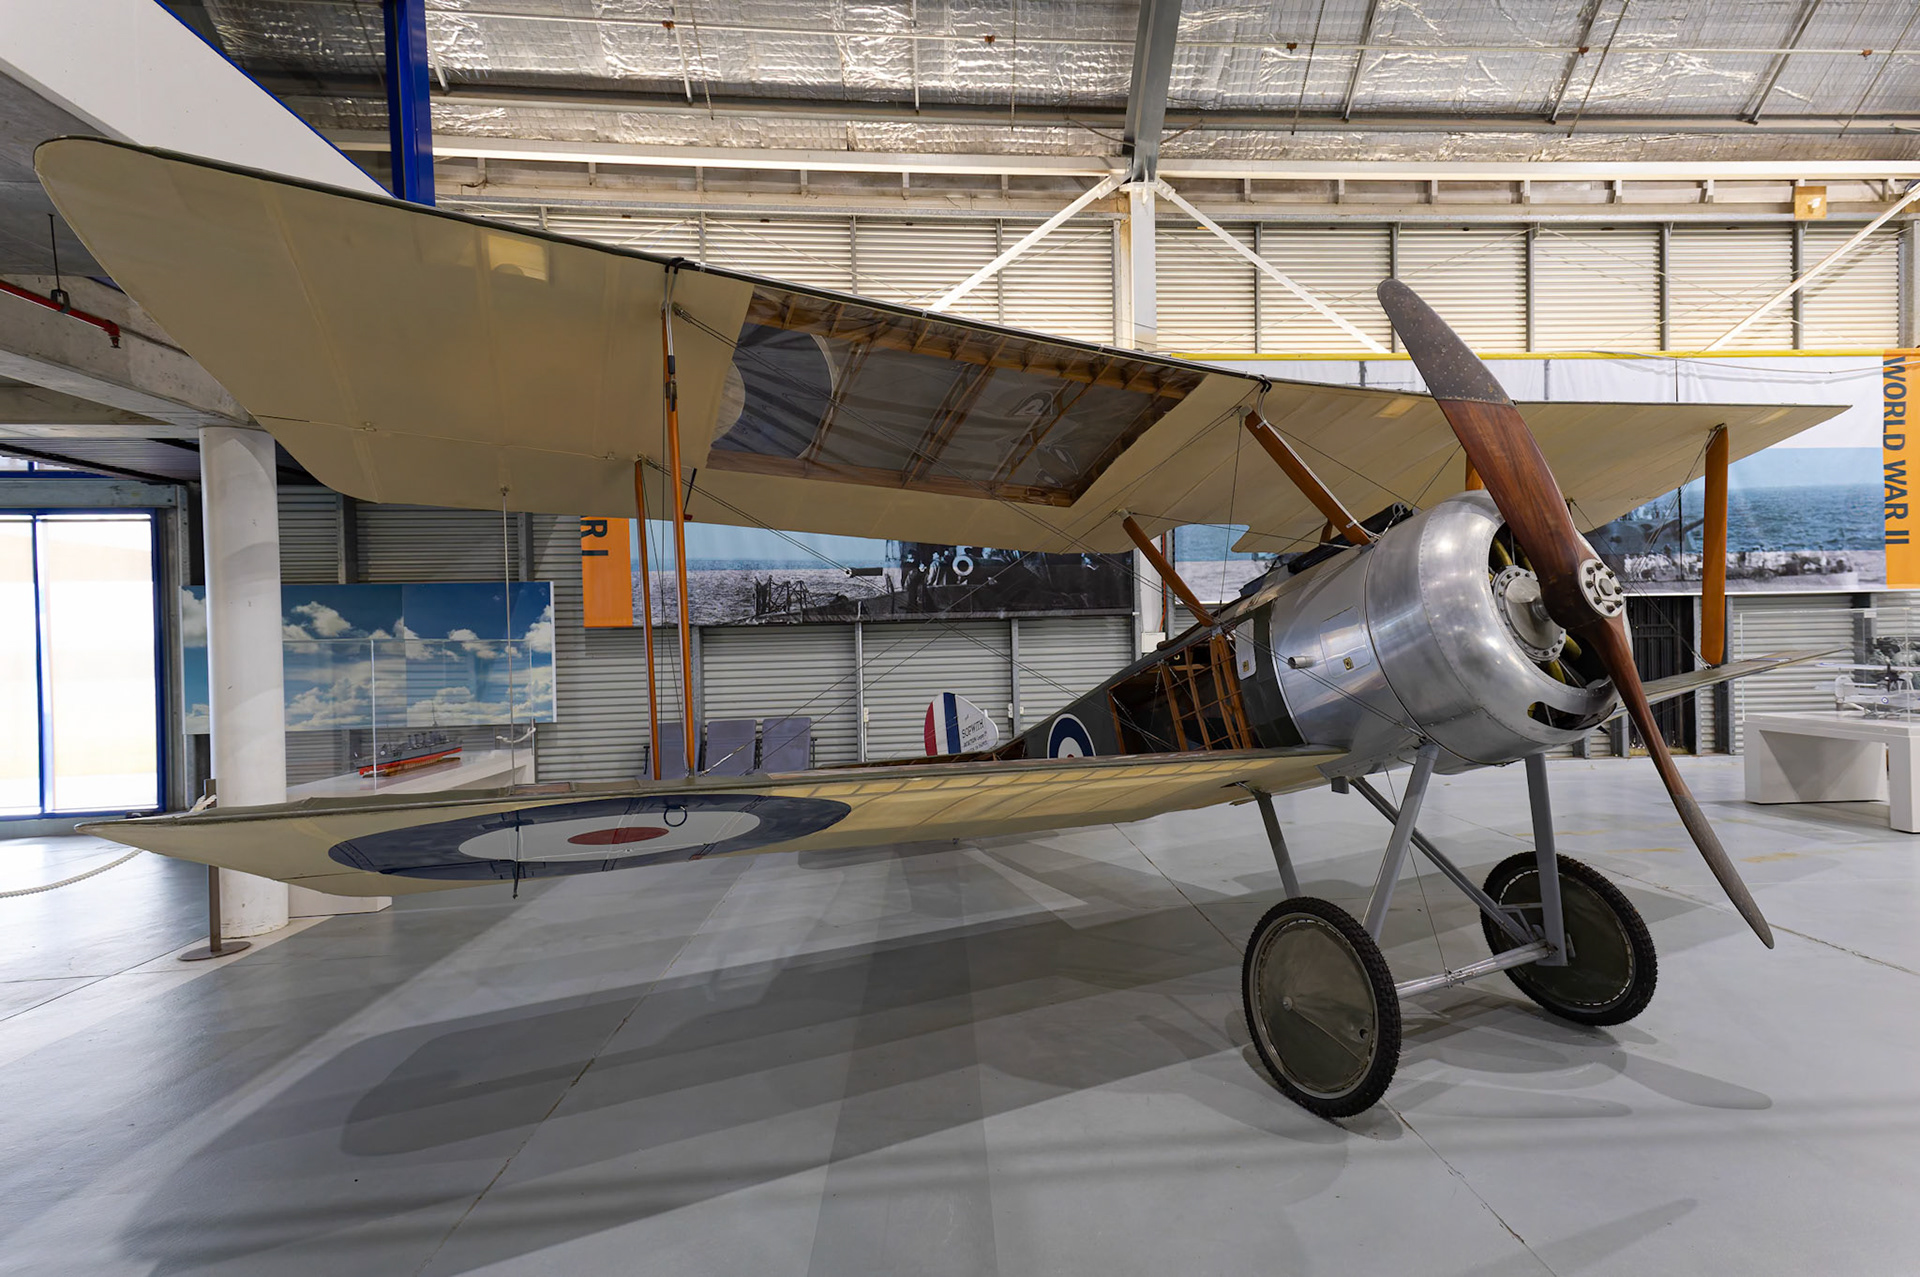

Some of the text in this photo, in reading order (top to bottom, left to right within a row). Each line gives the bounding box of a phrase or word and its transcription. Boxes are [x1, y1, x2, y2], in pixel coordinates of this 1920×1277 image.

[1882, 356, 1909, 544] WORLD WAR II
[580, 516, 608, 538] R
